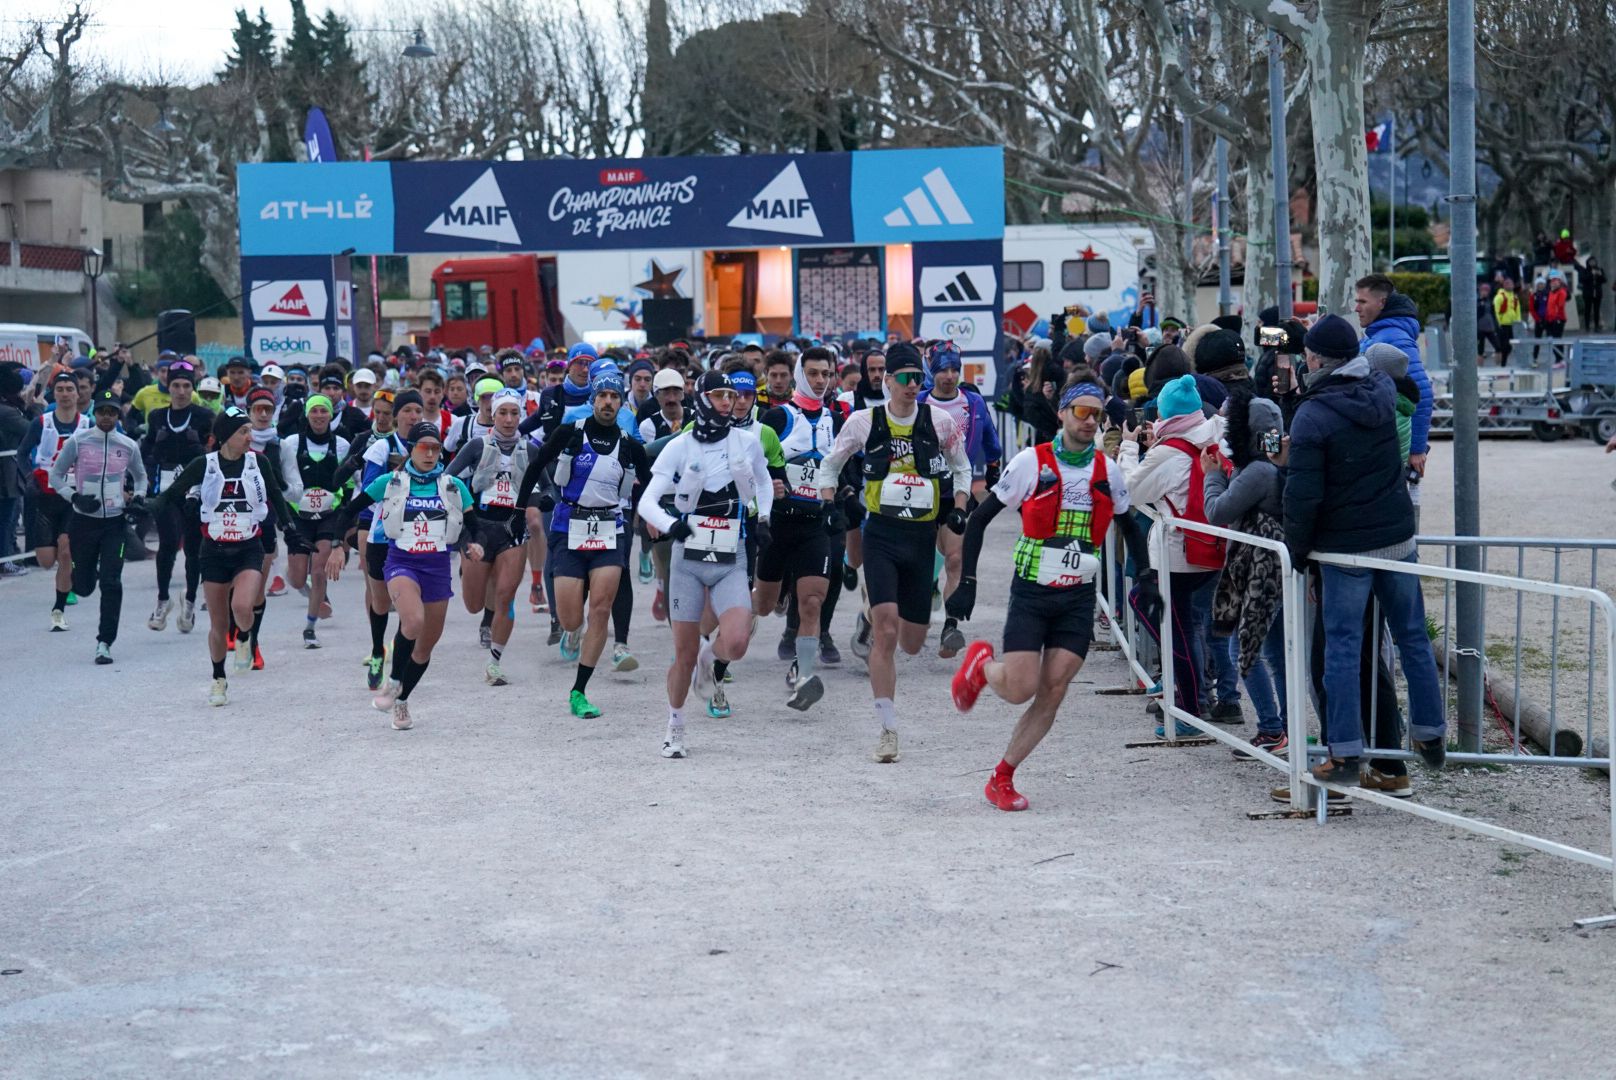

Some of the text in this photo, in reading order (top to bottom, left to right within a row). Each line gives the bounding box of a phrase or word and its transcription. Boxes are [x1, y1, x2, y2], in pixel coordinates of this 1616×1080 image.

[607, 173, 636, 182] MAIF
[548, 175, 698, 222] CHAMPIONNATS
[260, 193, 374, 220] ATHLÉ
[745, 199, 811, 220] MAIF
[443, 206, 509, 227] MAIF
[572, 206, 672, 239] DE FRANCE
[275, 299, 306, 311] MAIF
[259, 336, 311, 352] Bédoin
[801, 467, 815, 482] 34
[497, 480, 510, 493] 60
[795, 487, 817, 497] MAIF
[904, 486, 912, 501] 3
[310, 498, 322, 509] 53
[223, 512, 237, 526] 62
[704, 518, 729, 528] MAIF
[414, 521, 429, 537] 54
[587, 522, 598, 535] 14
[220, 532, 244, 540] MAIF
[711, 530, 716, 544] 1
[412, 543, 436, 552] MAIF
[582, 541, 606, 549] MAIF
[1062, 551, 1081, 570] 40
